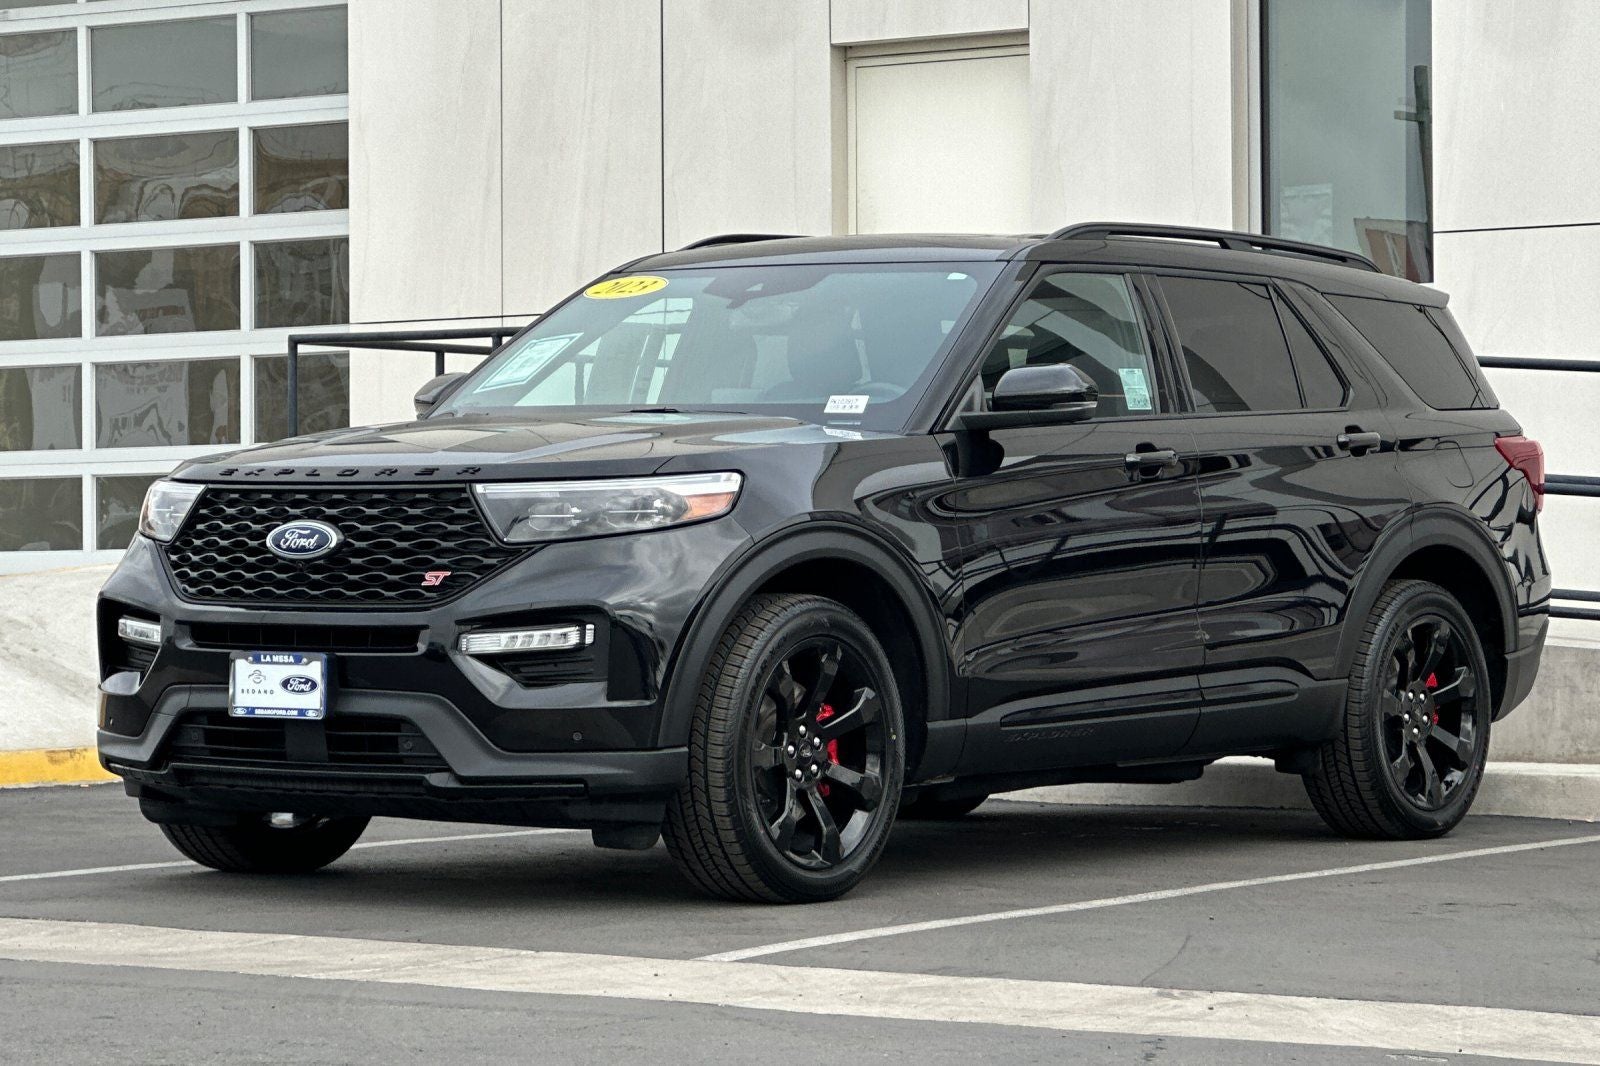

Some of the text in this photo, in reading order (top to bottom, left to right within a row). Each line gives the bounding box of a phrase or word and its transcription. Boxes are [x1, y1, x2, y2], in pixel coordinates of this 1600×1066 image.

[590, 280, 659, 296] 2023
[219, 466, 481, 477] EXPLORER
[280, 528, 317, 550] Ford
[421, 571, 451, 586] ST
[260, 654, 295, 664] LA MESA
[287, 677, 312, 692] Ford
